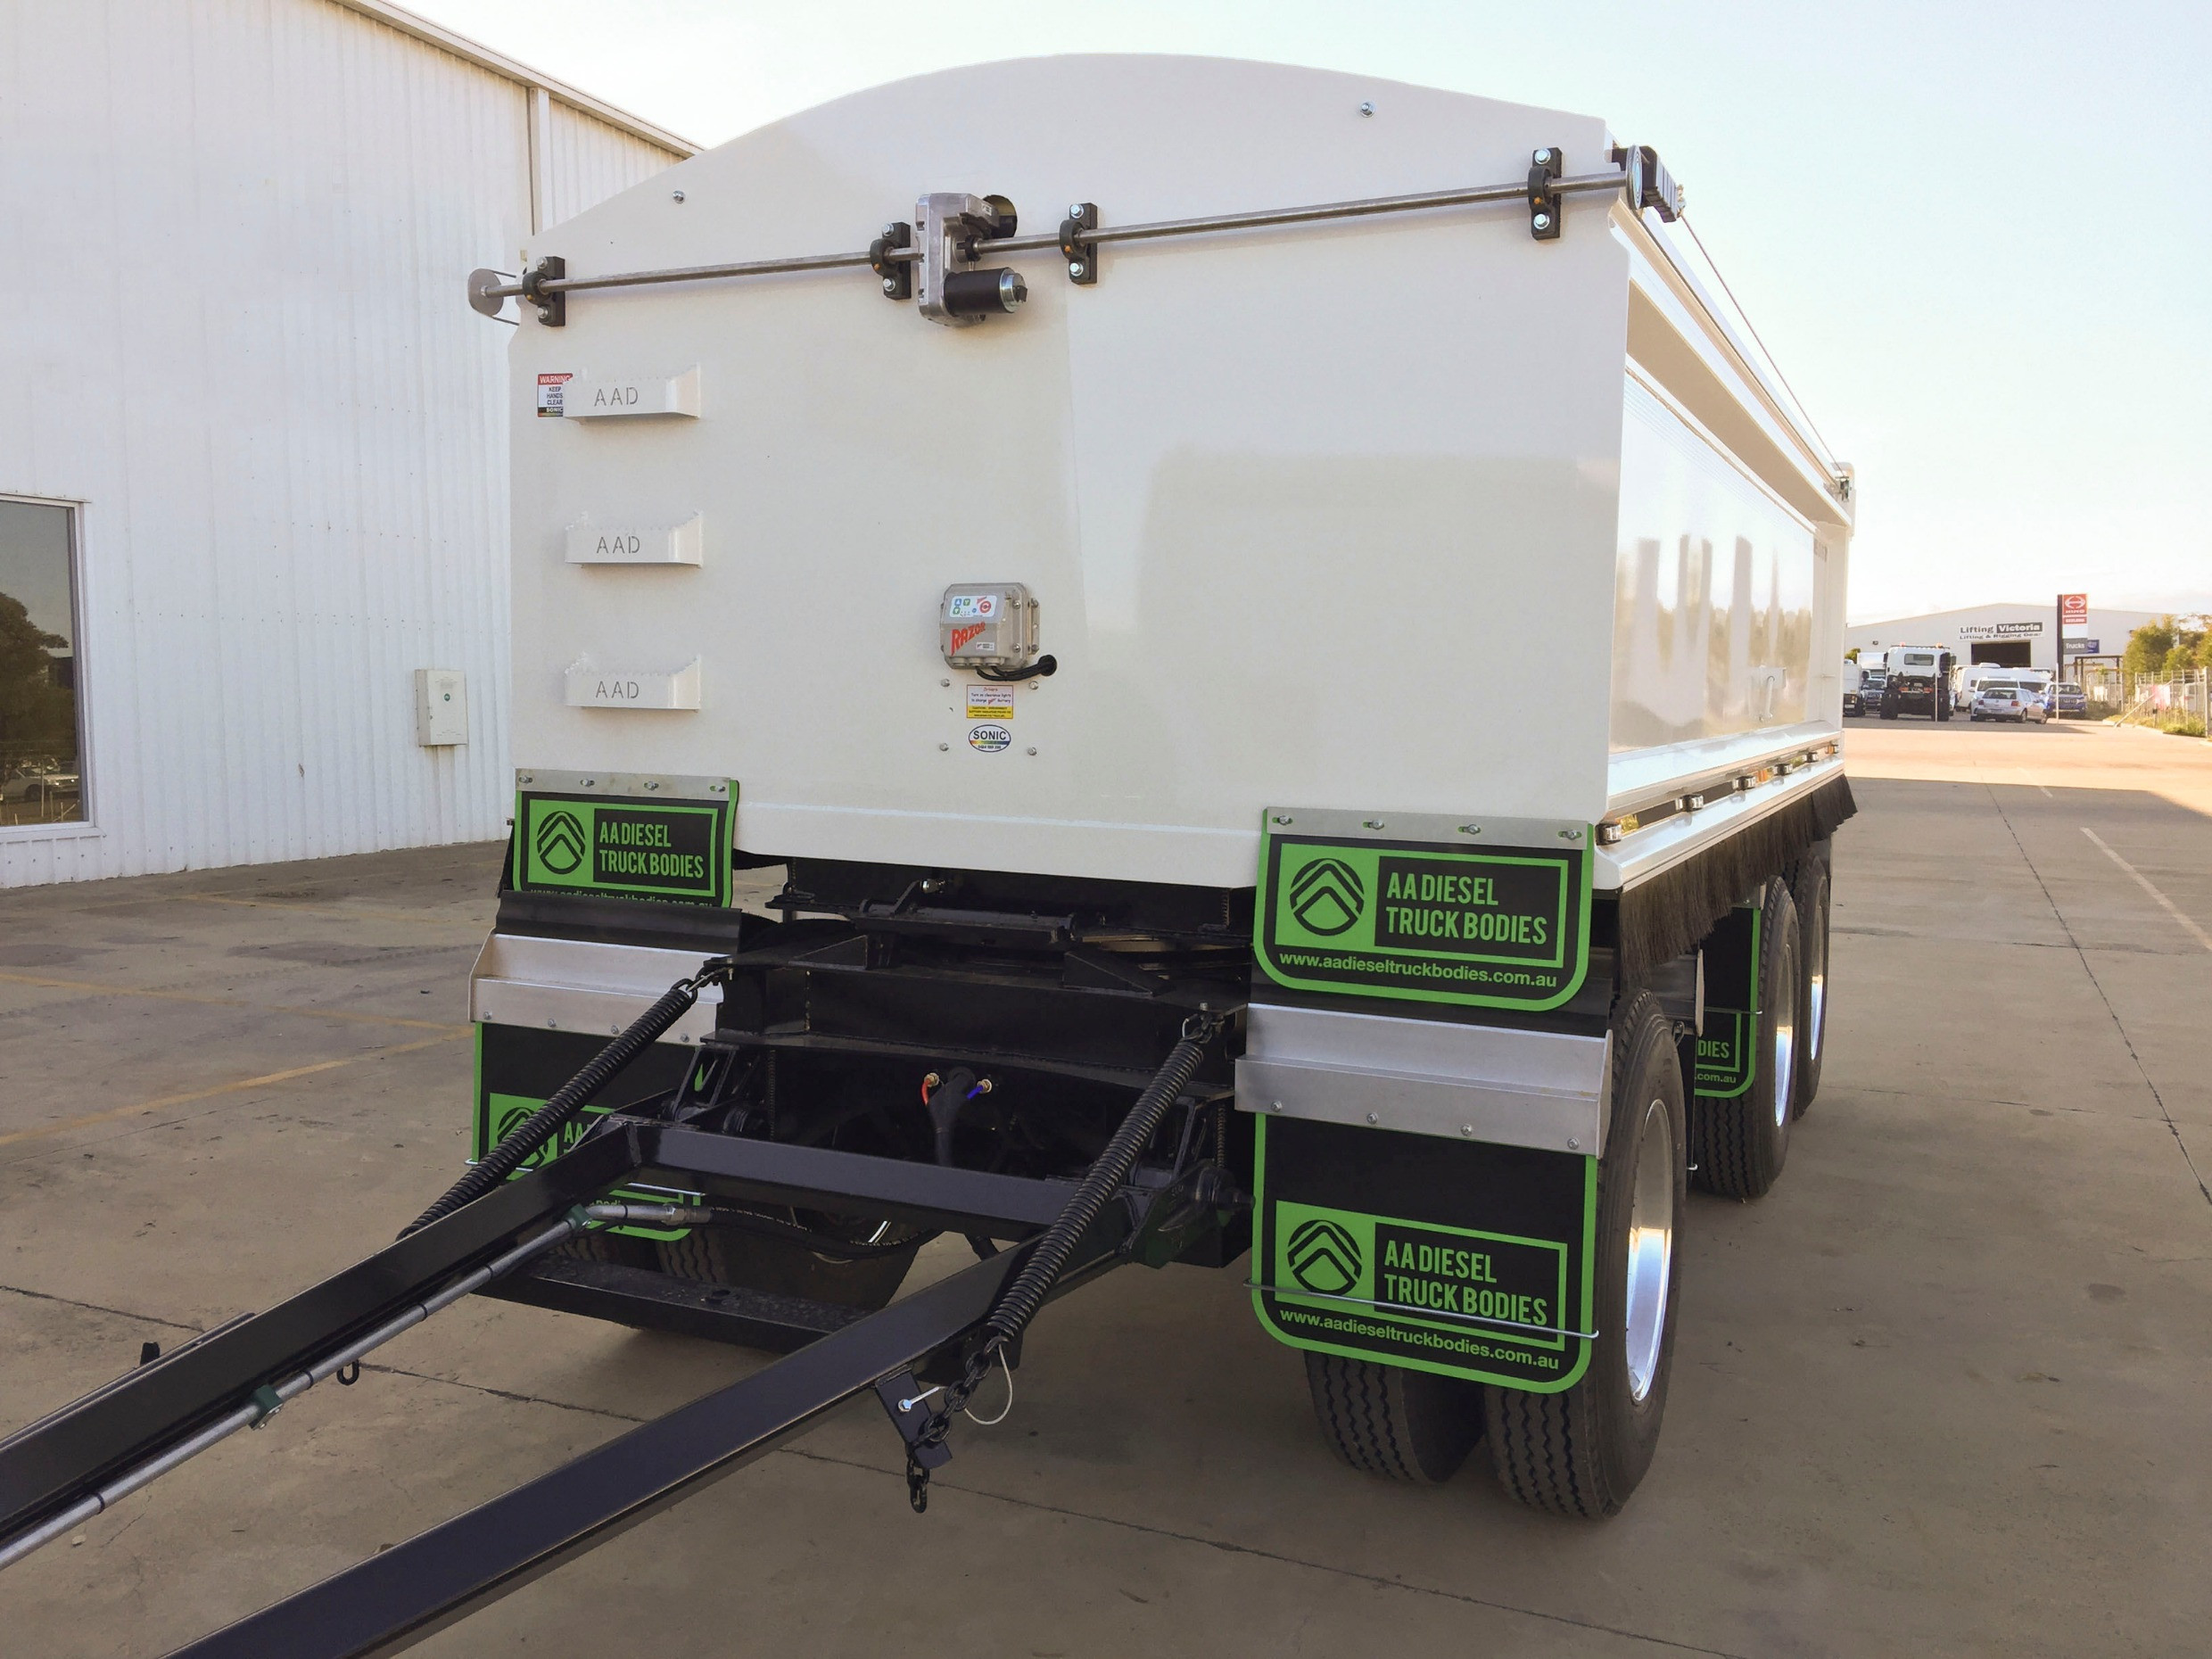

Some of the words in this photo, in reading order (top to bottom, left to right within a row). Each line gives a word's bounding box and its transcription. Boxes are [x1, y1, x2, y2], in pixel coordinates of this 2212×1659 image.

[540, 375, 571, 384] WARNING
[594, 386, 639, 407] AAD
[596, 535, 641, 555] AAD
[951, 620, 986, 656] RAZOR
[1999, 623, 2040, 632] Victoria
[596, 680, 640, 699] AAD
[973, 730, 1006, 740] SONIC
[599, 821, 620, 845] AA
[621, 822, 672, 848] DIESEL
[599, 849, 648, 875] TRUCK
[649, 852, 705, 879] BODIES
[1387, 871, 1417, 901] AA
[1422, 874, 1499, 906] DIESEL
[1385, 906, 1459, 939] TRUCK
[1464, 912, 1548, 945] BODIES
[1279, 953, 1557, 987] www.aadieseltruckbodies.com.au
[1697, 1040, 1729, 1059] DIES
[1383, 1240, 1416, 1270] AA
[1418, 1246, 1498, 1283] DIESEL
[1383, 1274, 1459, 1312] TRUCK
[1463, 1284, 1548, 1326] BODIES
[1280, 1309, 1559, 1370] www.aadieseltruckbodies.com.au
